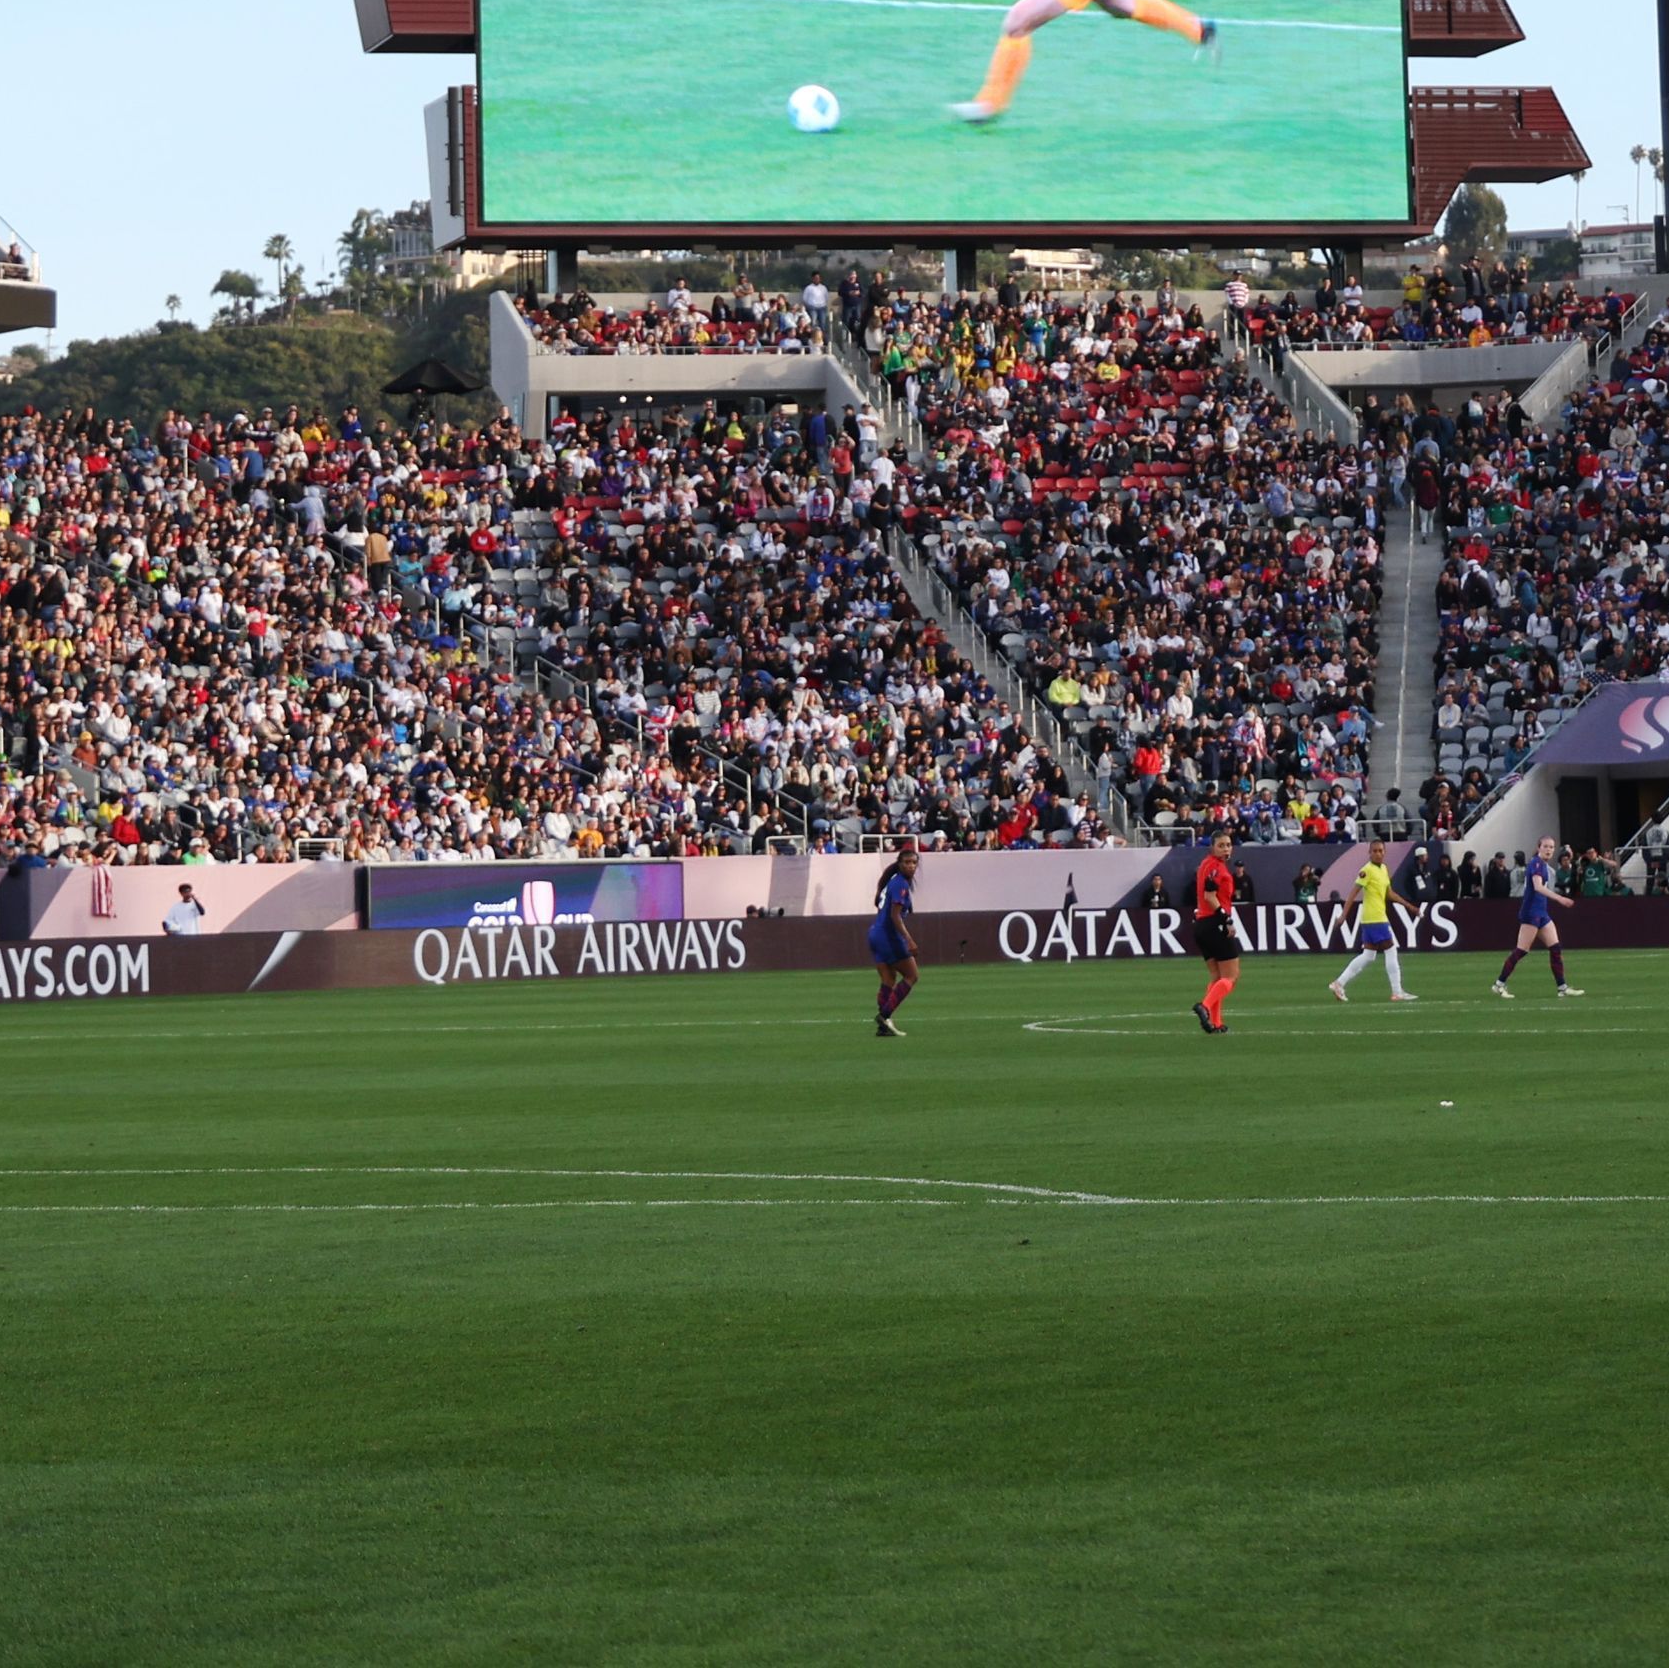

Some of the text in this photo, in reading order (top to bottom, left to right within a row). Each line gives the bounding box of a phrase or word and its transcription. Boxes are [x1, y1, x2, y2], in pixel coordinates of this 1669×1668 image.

[413, 919, 747, 985] QATAR AIRWAYS
[999, 908, 1186, 963] QATAR
